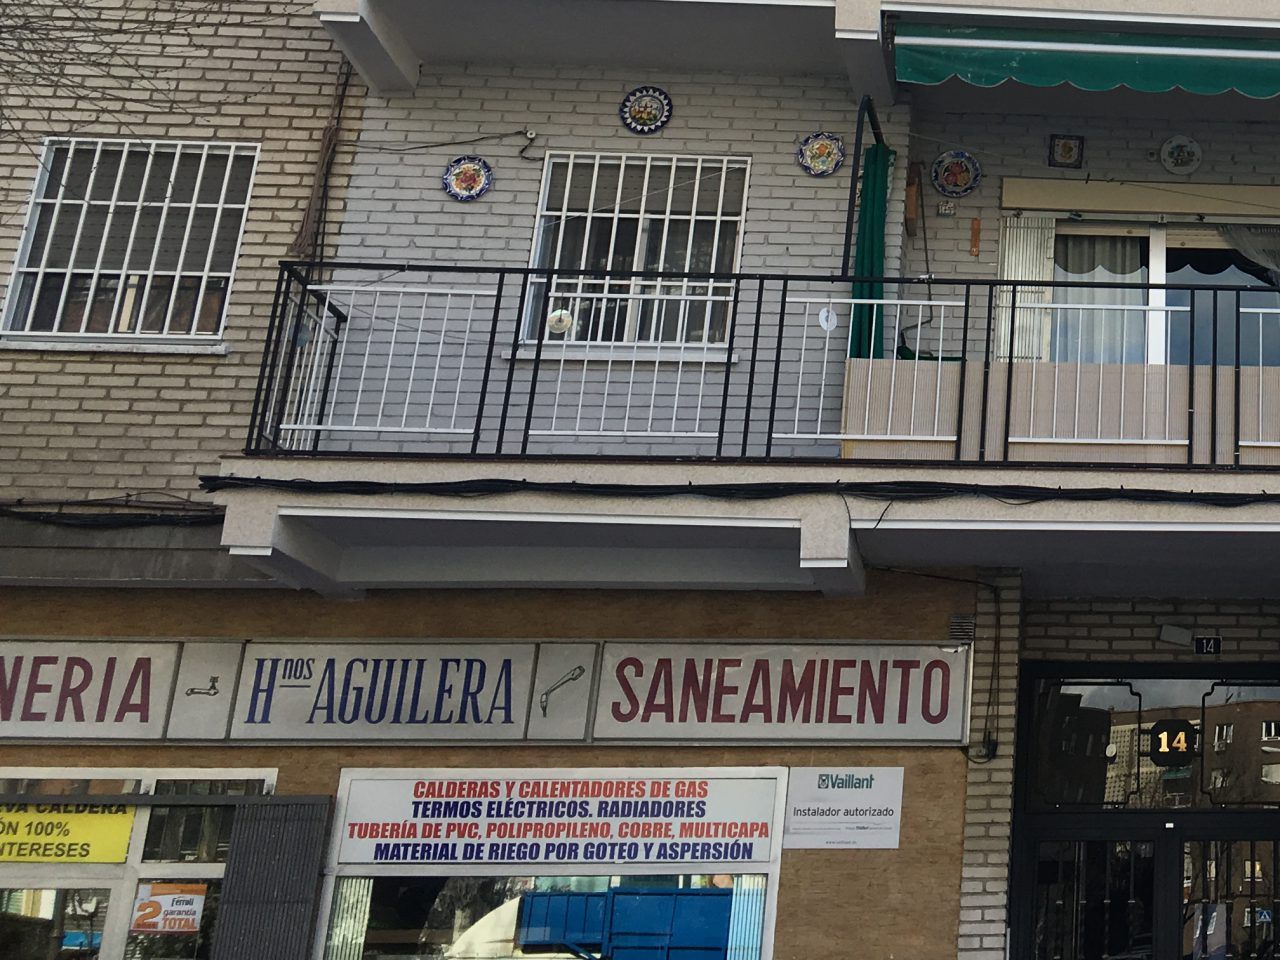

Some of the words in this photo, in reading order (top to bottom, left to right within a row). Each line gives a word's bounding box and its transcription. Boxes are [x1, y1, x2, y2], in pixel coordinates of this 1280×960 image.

[1202, 639, 1214, 653] 14
[305, 657, 515, 724] AGUILERA
[611, 657, 952, 725] SANEAMIENTO
[1158, 731, 1188, 753] 14
[413, 781, 500, 798] CALDERAS
[505, 781, 515, 798] Y
[519, 780, 646, 798] CALENTADORES
[650, 780, 671, 798] DE
[674, 780, 708, 798] GAS
[830, 774, 875, 789] Vaillant
[412, 800, 482, 818] TERMOS
[486, 797, 592, 818] ELÉCTRICOS.
[597, 800, 706, 818] RADIADORES
[793, 807, 841, 817] Instalador
[843, 807, 895, 817] autorizado
[24, 821, 70, 837] 100%
[348, 820, 417, 839] TUBERÍA
[421, 822, 442, 839] DE
[445, 822, 481, 840] PVC,
[486, 822, 613, 840] POLIPROPILENO,
[618, 822, 675, 840] COBRE,
[680, 822, 769, 839] MULTICAPA
[374, 843, 458, 860] MATERIAL
[462, 843, 485, 860] DE
[488, 843, 540, 860] RIEGO
[544, 843, 579, 860] POR
[583, 842, 639, 860] GOTEO
[644, 842, 654, 860] Y
[656, 839, 753, 860] ASPERSIÓN
[171, 896, 194, 907] Ferroli
[133, 900, 162, 929] 2
[162, 917, 197, 929] TOTAL
